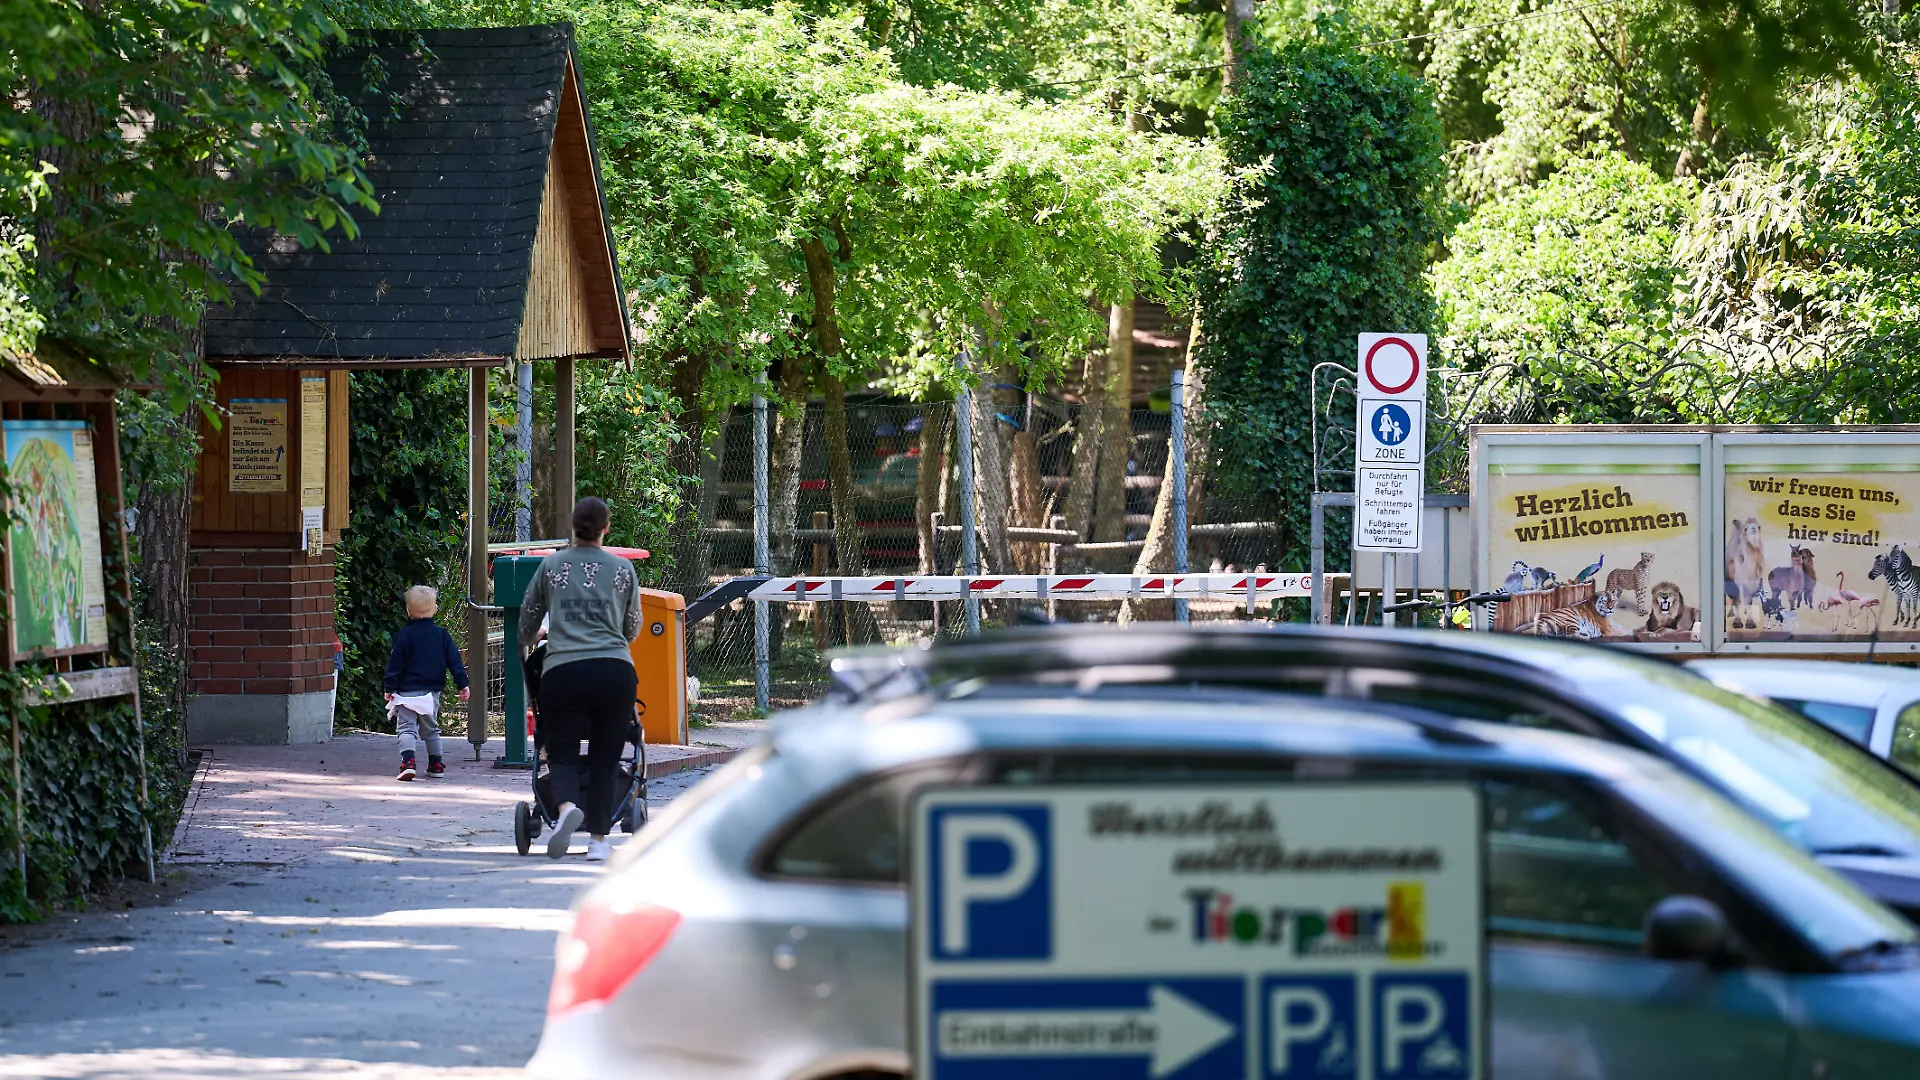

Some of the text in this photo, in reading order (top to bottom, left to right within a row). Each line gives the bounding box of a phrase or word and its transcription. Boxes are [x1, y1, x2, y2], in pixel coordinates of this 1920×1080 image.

[1375, 448, 1406, 459] ZONE
[1369, 472, 1408, 480] Durchfahrt
[1391, 480, 1402, 488] für
[1375, 487, 1404, 496] Befugte
[1515, 485, 1633, 518] Herzlich
[1748, 477, 1901, 506] wir freuen uns,
[1364, 499, 1413, 509] Schritttempo
[1777, 500, 1856, 521] dass Sie
[1368, 519, 1408, 529] Fußgänger
[1387, 528, 1412, 536] immer
[1515, 509, 1689, 543] willkommen
[1787, 522, 1880, 547] hier sind!
[1373, 535, 1403, 545] Vorrang
[560, 598, 581, 609] NEW
[941, 814, 1040, 953] P
[1184, 882, 1425, 958] Tierpark
[948, 1017, 1160, 1048] Einbahnstraße
[1269, 987, 1331, 1074] P
[1382, 985, 1444, 1073] P
